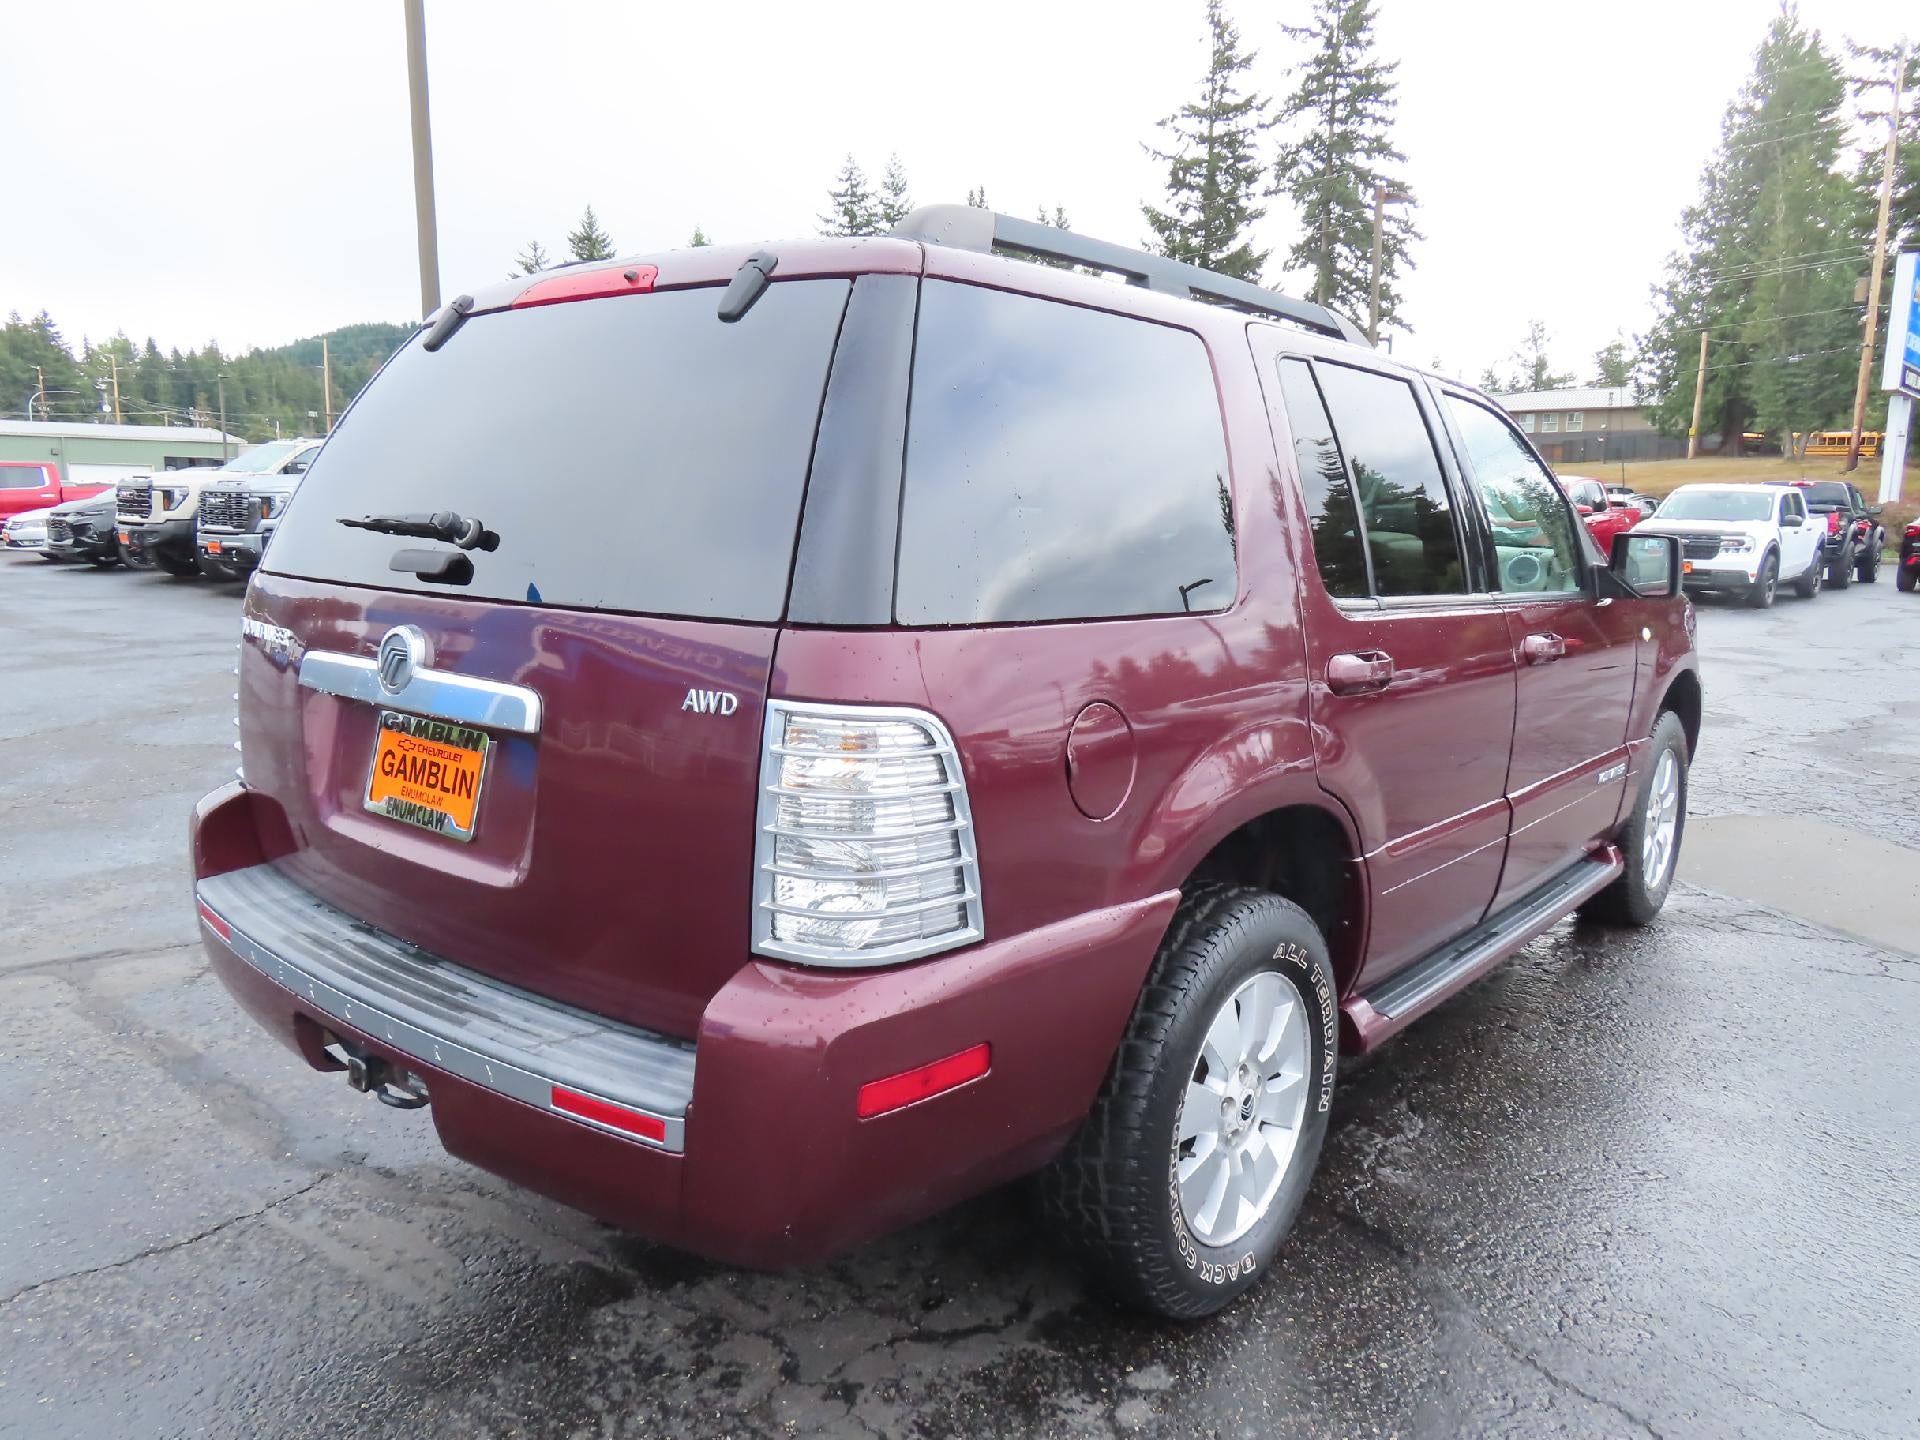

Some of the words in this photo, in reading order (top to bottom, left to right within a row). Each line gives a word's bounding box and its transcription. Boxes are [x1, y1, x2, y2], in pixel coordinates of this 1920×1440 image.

[681, 689, 739, 716] AWD
[384, 712, 484, 752] GAMBLIN
[417, 744, 463, 764] CHEVROLET
[381, 749, 475, 800] GAMBLIN
[401, 785, 444, 807] ENUMCLAW
[385, 796, 447, 832] ENUMCLAW
[1272, 942, 1308, 970] ALL
[1310, 962, 1335, 1113] TERRAIN
[1200, 1251, 1256, 1285] BACK
